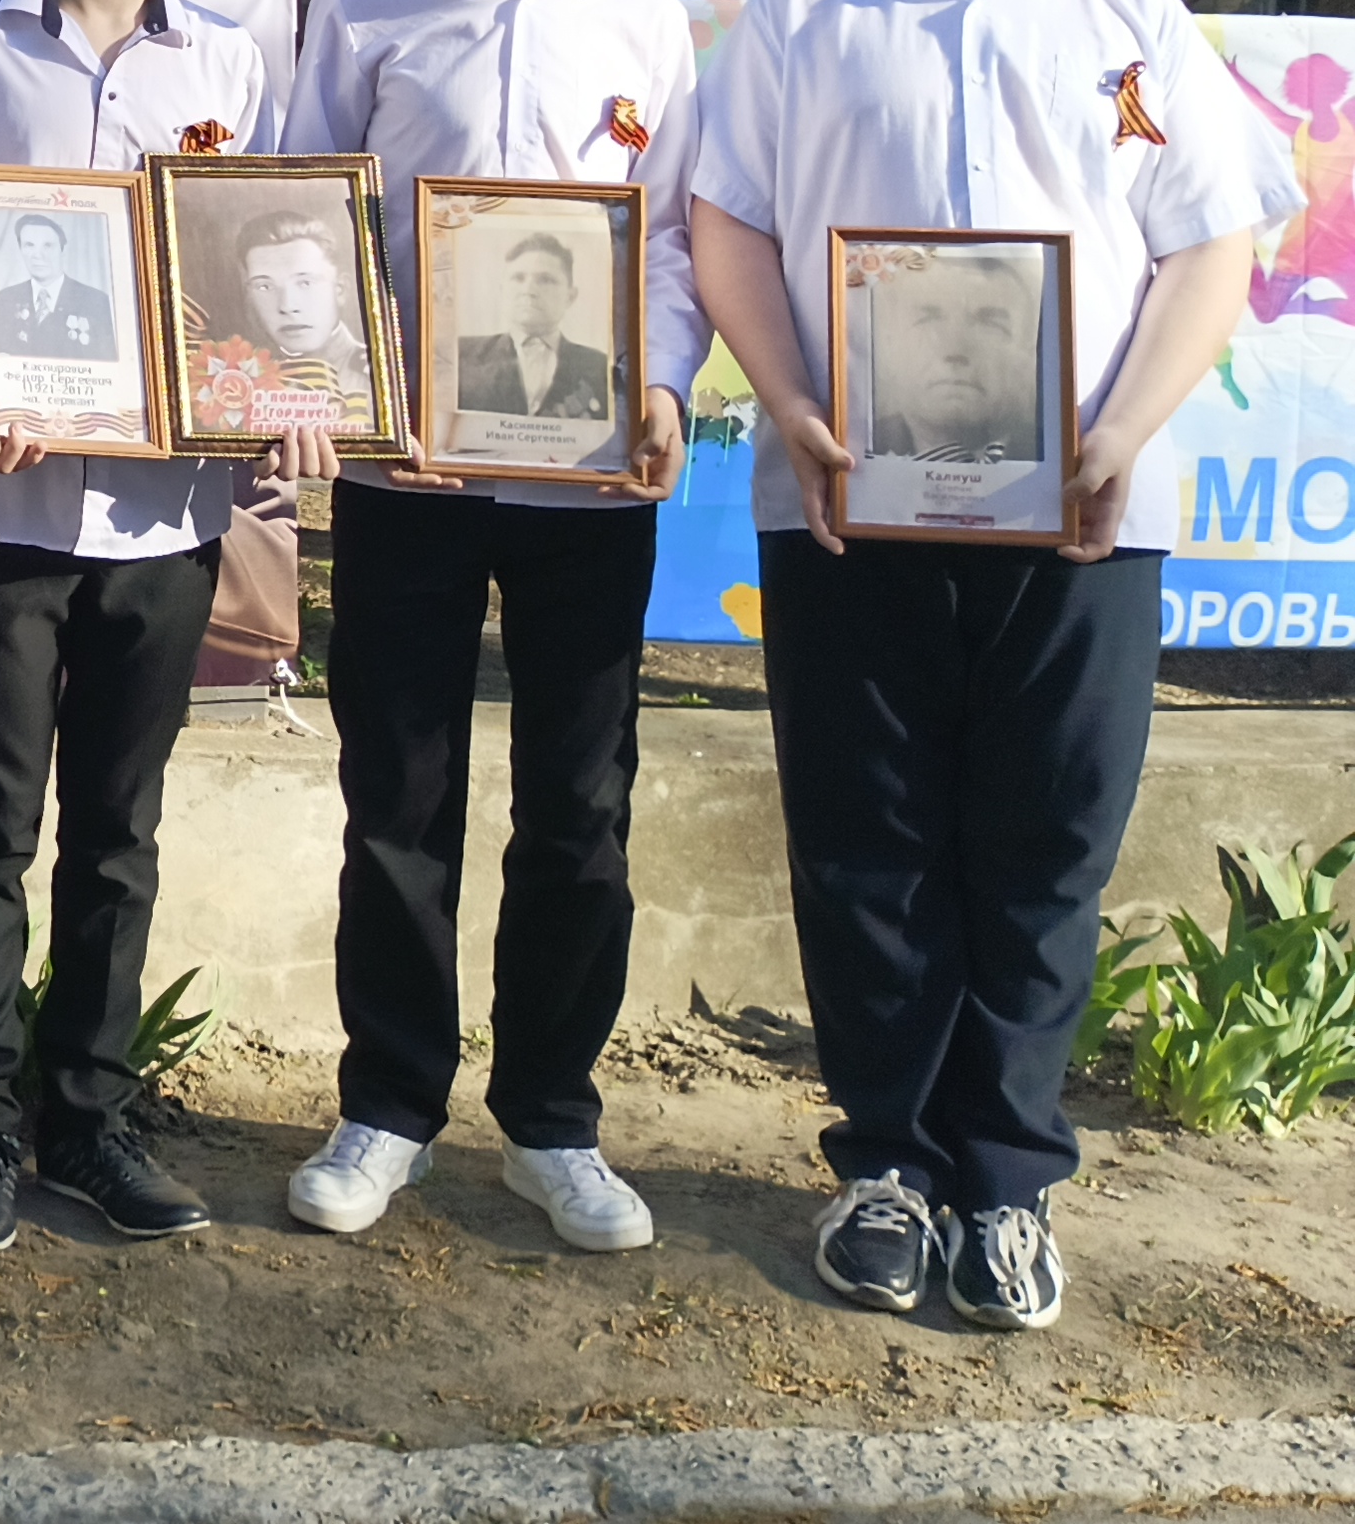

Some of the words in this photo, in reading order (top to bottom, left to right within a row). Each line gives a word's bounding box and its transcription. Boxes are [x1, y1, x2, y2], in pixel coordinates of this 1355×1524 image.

[271, 392, 326, 404] ПОМНЮ!
[269, 407, 337, 419] ГОРЖУСЬ!
[486, 431, 514, 440] Иван
[517, 432, 576, 444] Сергеевич
